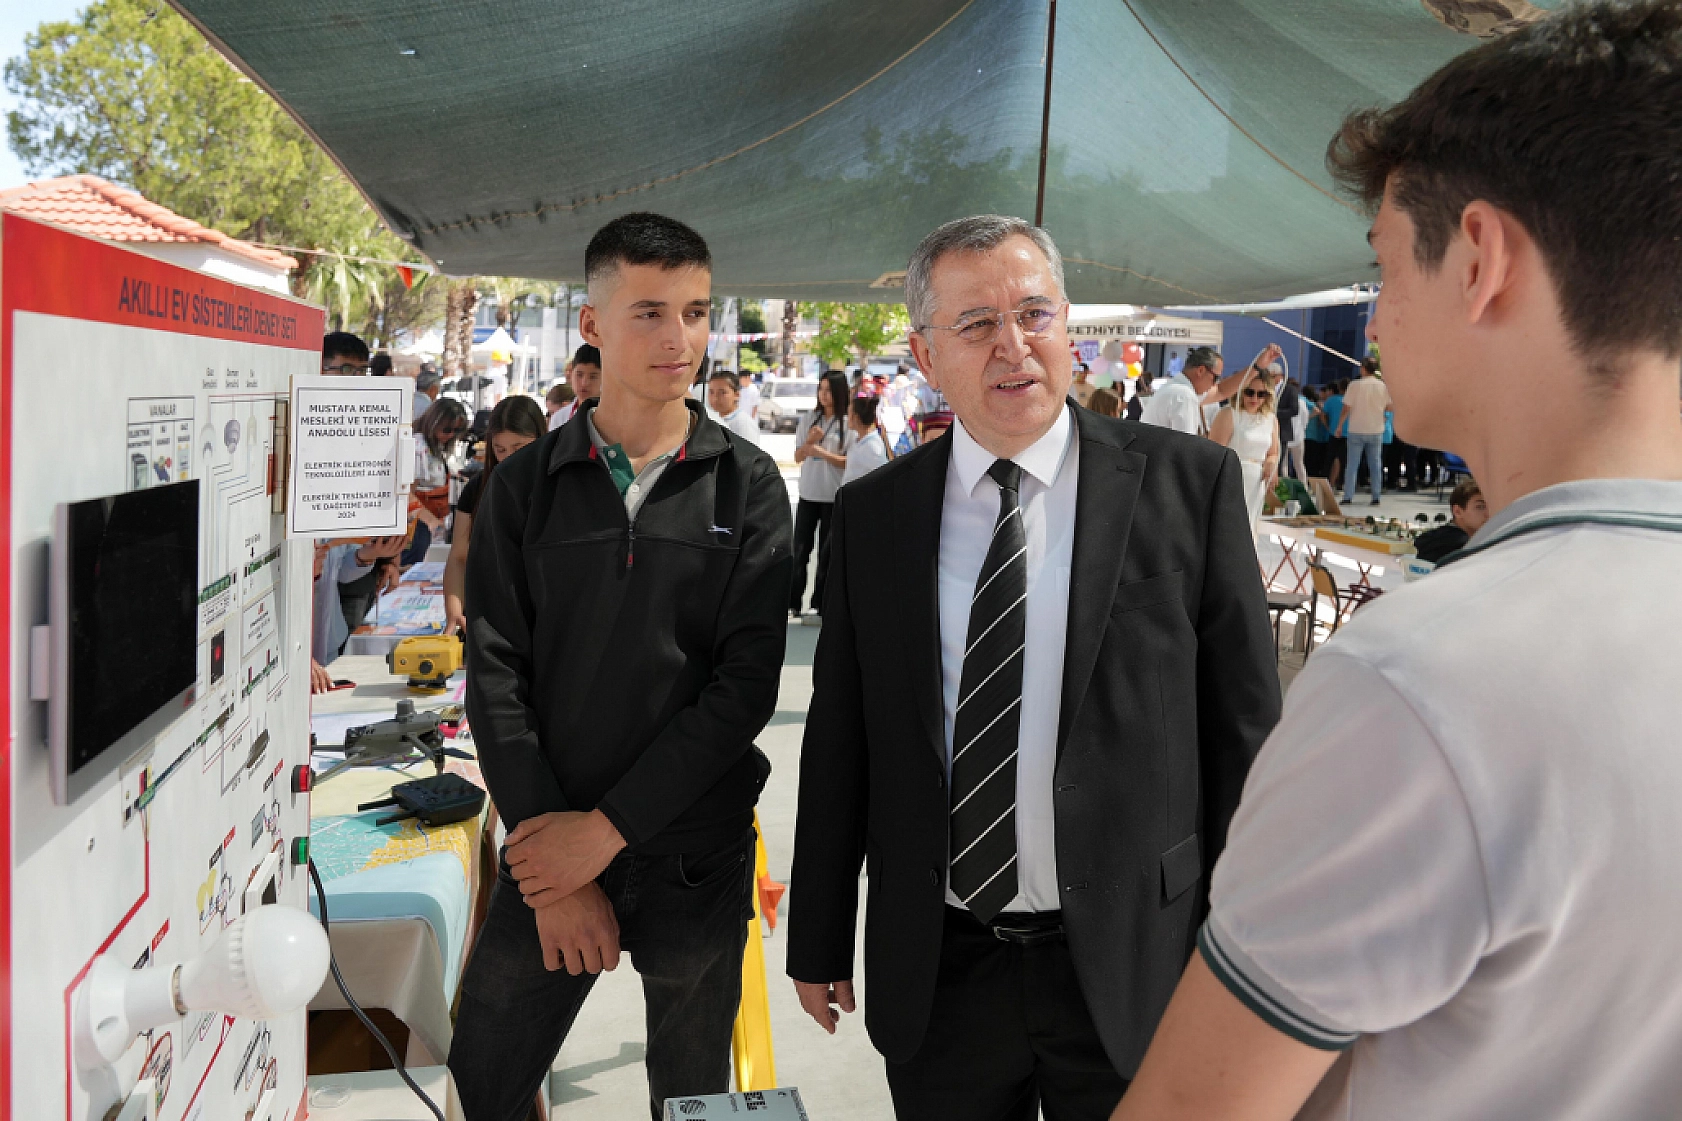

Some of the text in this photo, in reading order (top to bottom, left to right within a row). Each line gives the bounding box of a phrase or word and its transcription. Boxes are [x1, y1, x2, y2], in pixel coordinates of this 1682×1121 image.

[118, 276, 169, 318] AKILLI
[172, 288, 190, 322] EV
[192, 288, 253, 333] SİSTEMLERİ
[254, 309, 282, 338] DENEY
[309, 404, 391, 413] MUSTAFA KEMAL
[300, 415, 399, 426] MESLEKİ VE TEKNİK
[307, 426, 391, 437] ANADOLU LİSESİ
[304, 460, 392, 470] ELEKTRİK ELEKTRONİK
[302, 492, 340, 502] ELEKTRİK
[312, 503, 321, 511] VE
[337, 511, 356, 519] 2024
